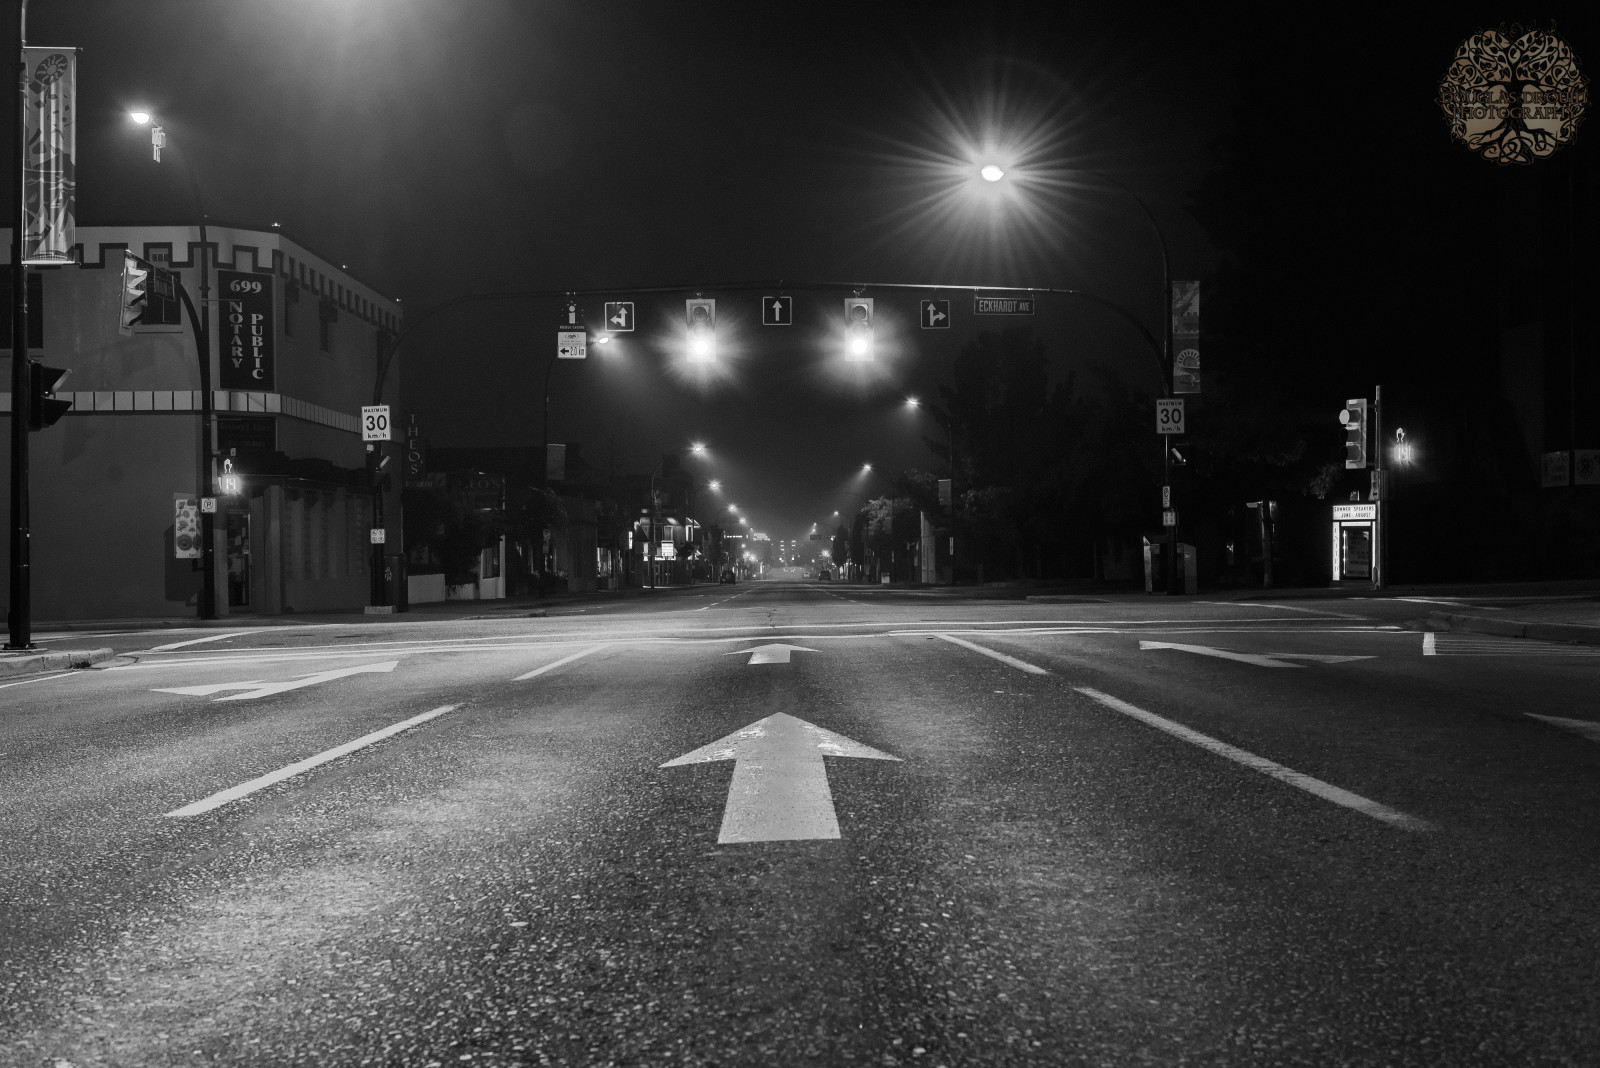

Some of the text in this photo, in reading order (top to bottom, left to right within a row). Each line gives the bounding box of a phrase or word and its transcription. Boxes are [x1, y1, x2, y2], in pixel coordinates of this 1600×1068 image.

[230, 280, 262, 293] 699
[979, 300, 1030, 312] ECKHARDT AVE
[229, 301, 243, 368] NOTARY
[251, 313, 264, 379] PUBLIC
[366, 414, 387, 431] 30
[1160, 408, 1182, 424] 30
[408, 413, 424, 475] THEO'S
